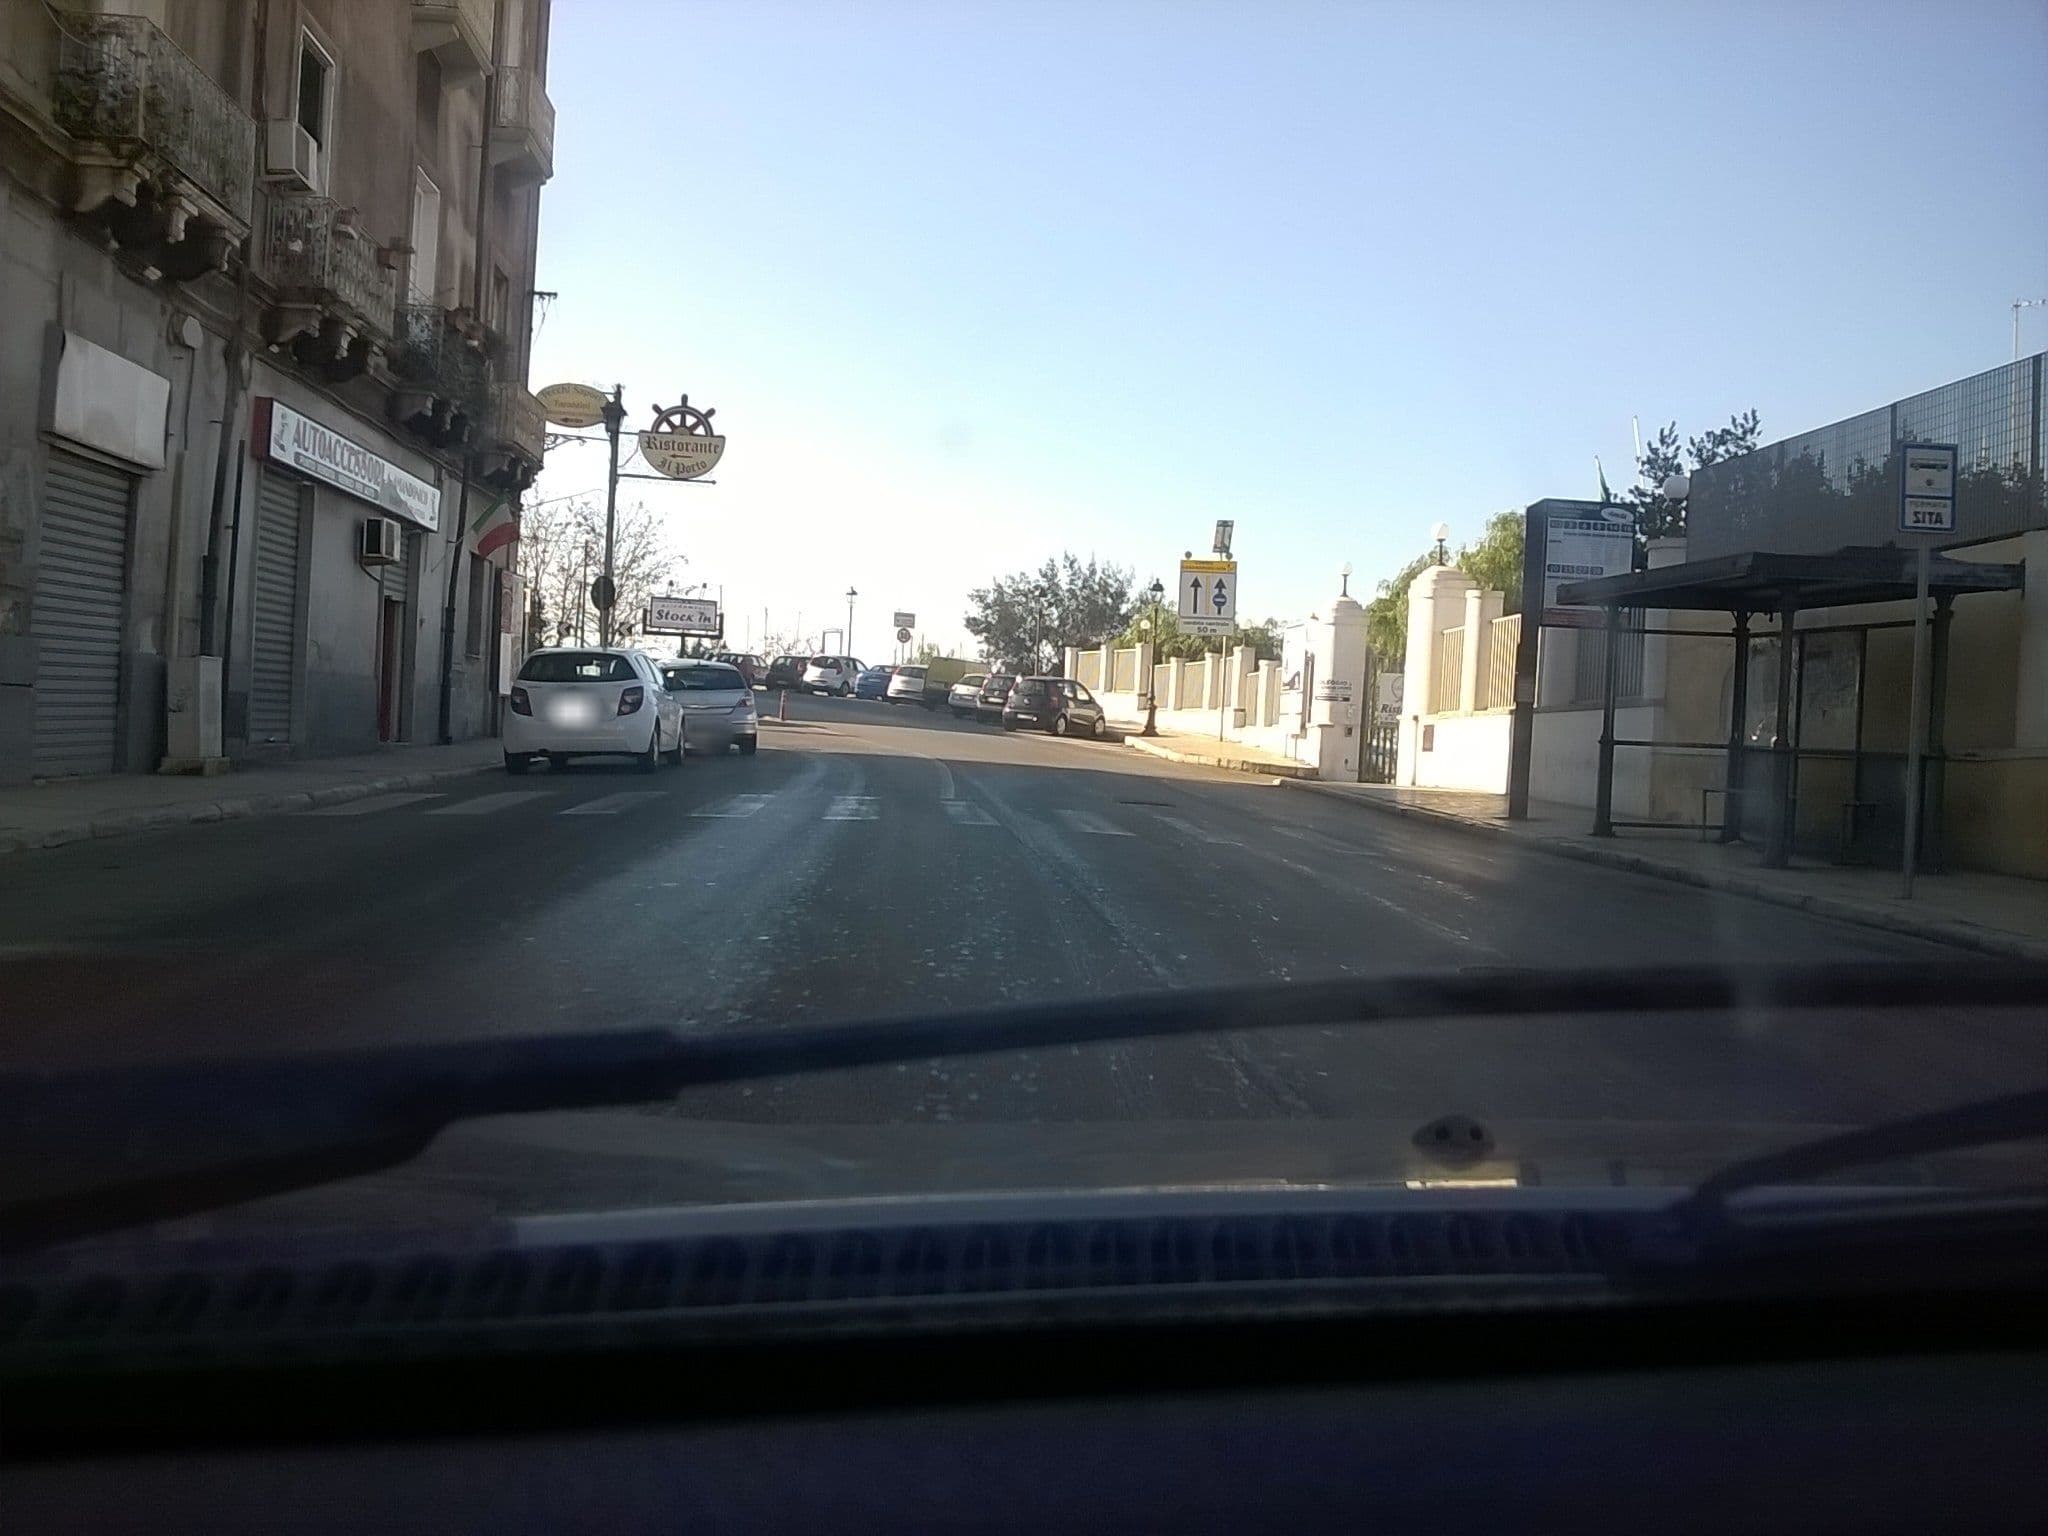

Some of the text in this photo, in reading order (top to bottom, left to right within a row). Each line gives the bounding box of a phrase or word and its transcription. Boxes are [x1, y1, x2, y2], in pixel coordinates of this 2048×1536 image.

[645, 435, 720, 454] Ristorante
[674, 460, 708, 476] Porto
[655, 609, 694, 622] Stock
